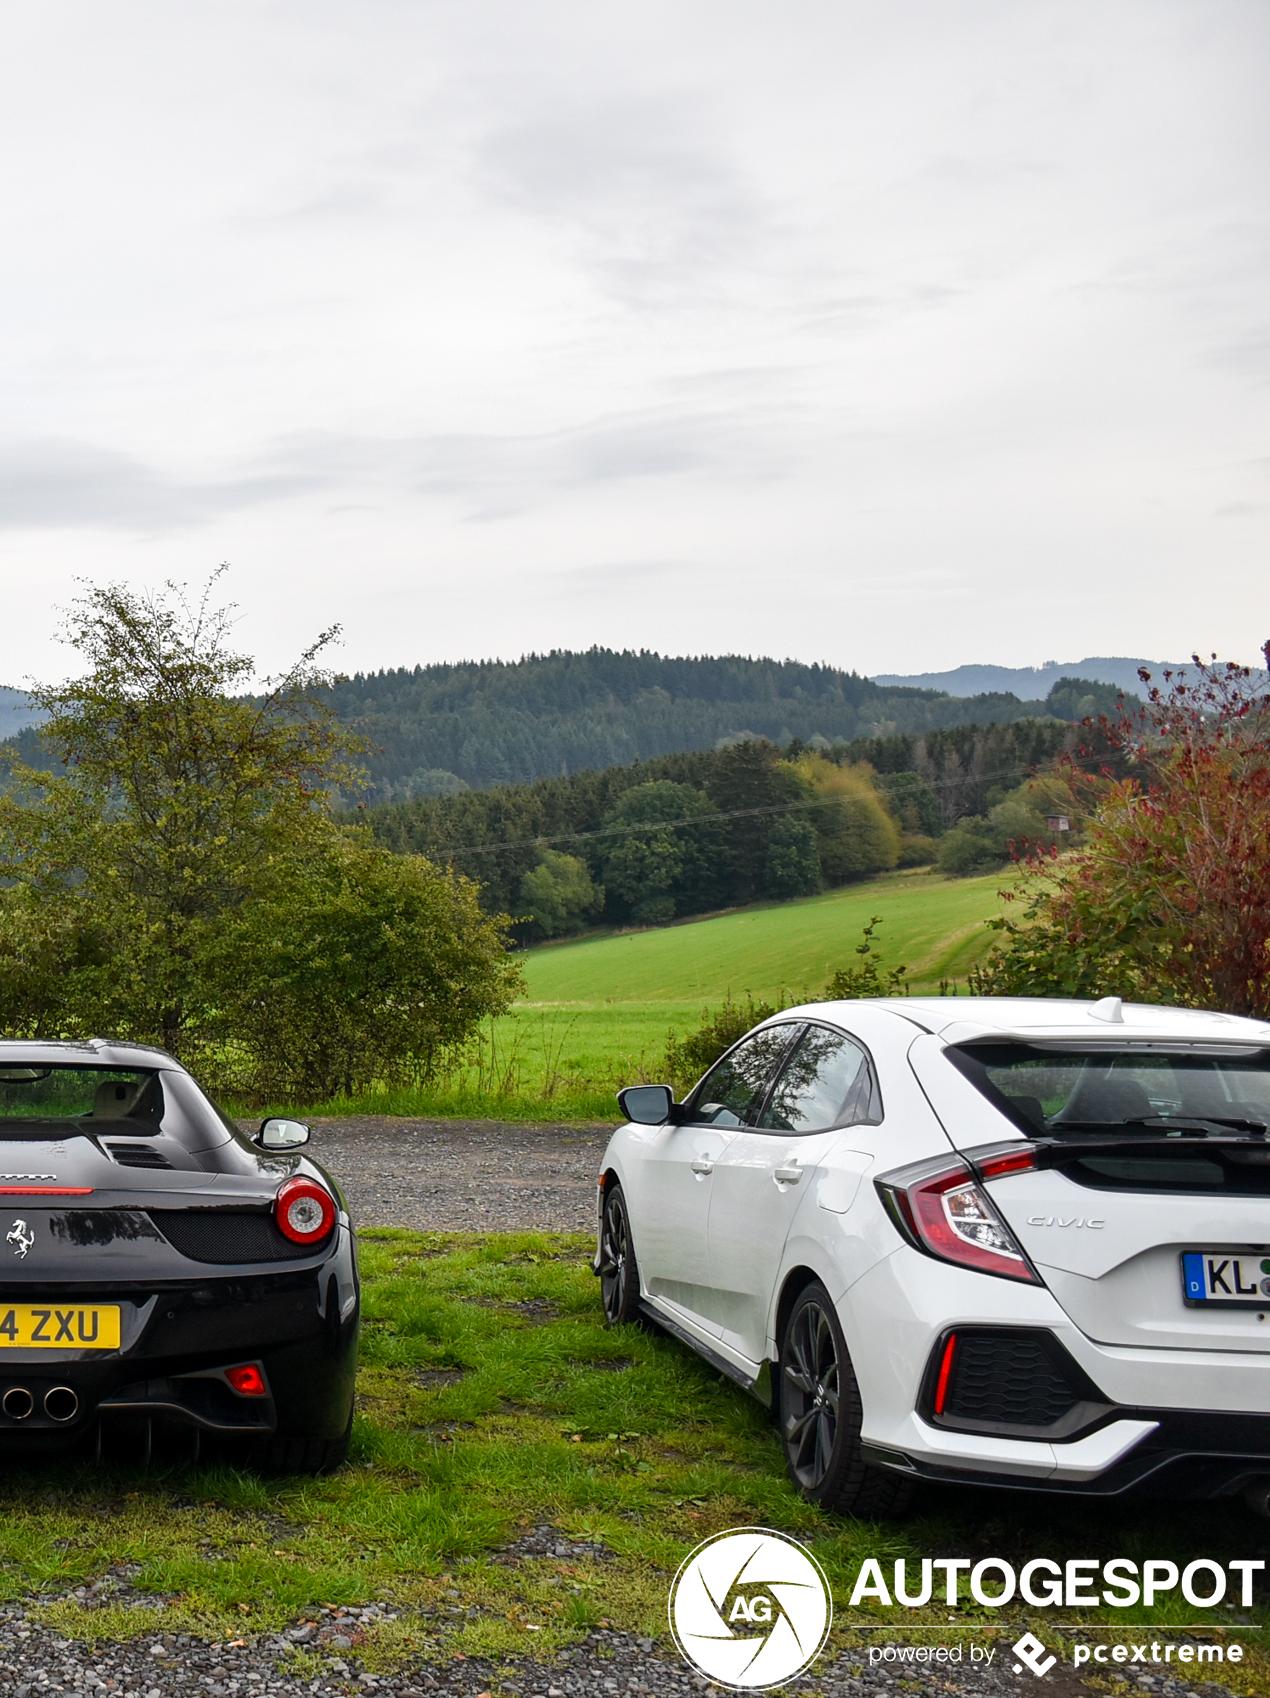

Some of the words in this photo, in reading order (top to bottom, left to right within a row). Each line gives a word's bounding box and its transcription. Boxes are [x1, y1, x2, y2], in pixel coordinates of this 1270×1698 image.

[1026, 1216, 1105, 1229] CIVIC
[1191, 1281, 1199, 1292] D
[1207, 1260, 1258, 1294] KL
[31, 1310, 98, 1342] ZXU
